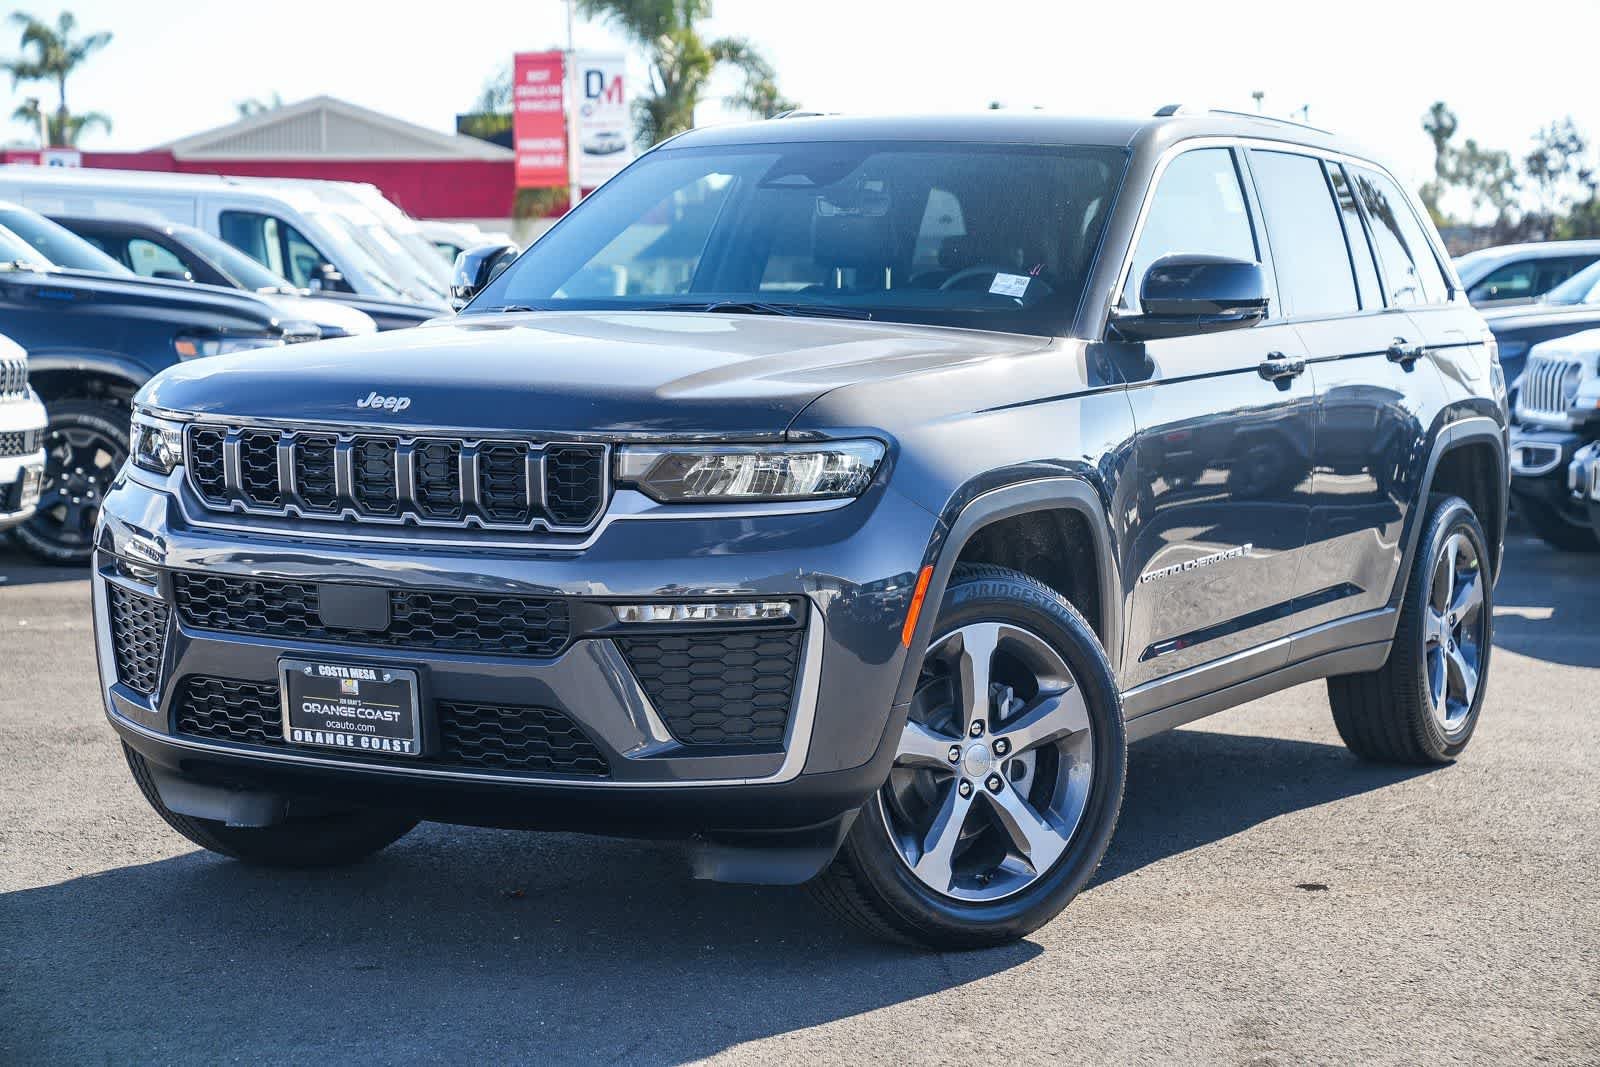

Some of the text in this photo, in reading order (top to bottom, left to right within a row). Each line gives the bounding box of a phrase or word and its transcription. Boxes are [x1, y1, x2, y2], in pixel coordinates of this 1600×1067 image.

[356, 391, 411, 413] Jeep
[1142, 546, 1243, 584] GRAND CHEROKEE
[318, 665, 377, 681] COSTA MESA
[302, 702, 401, 722] ORANGE COAST
[326, 719, 376, 733] ocauto.com
[293, 729, 411, 753] ORANGE COAST
